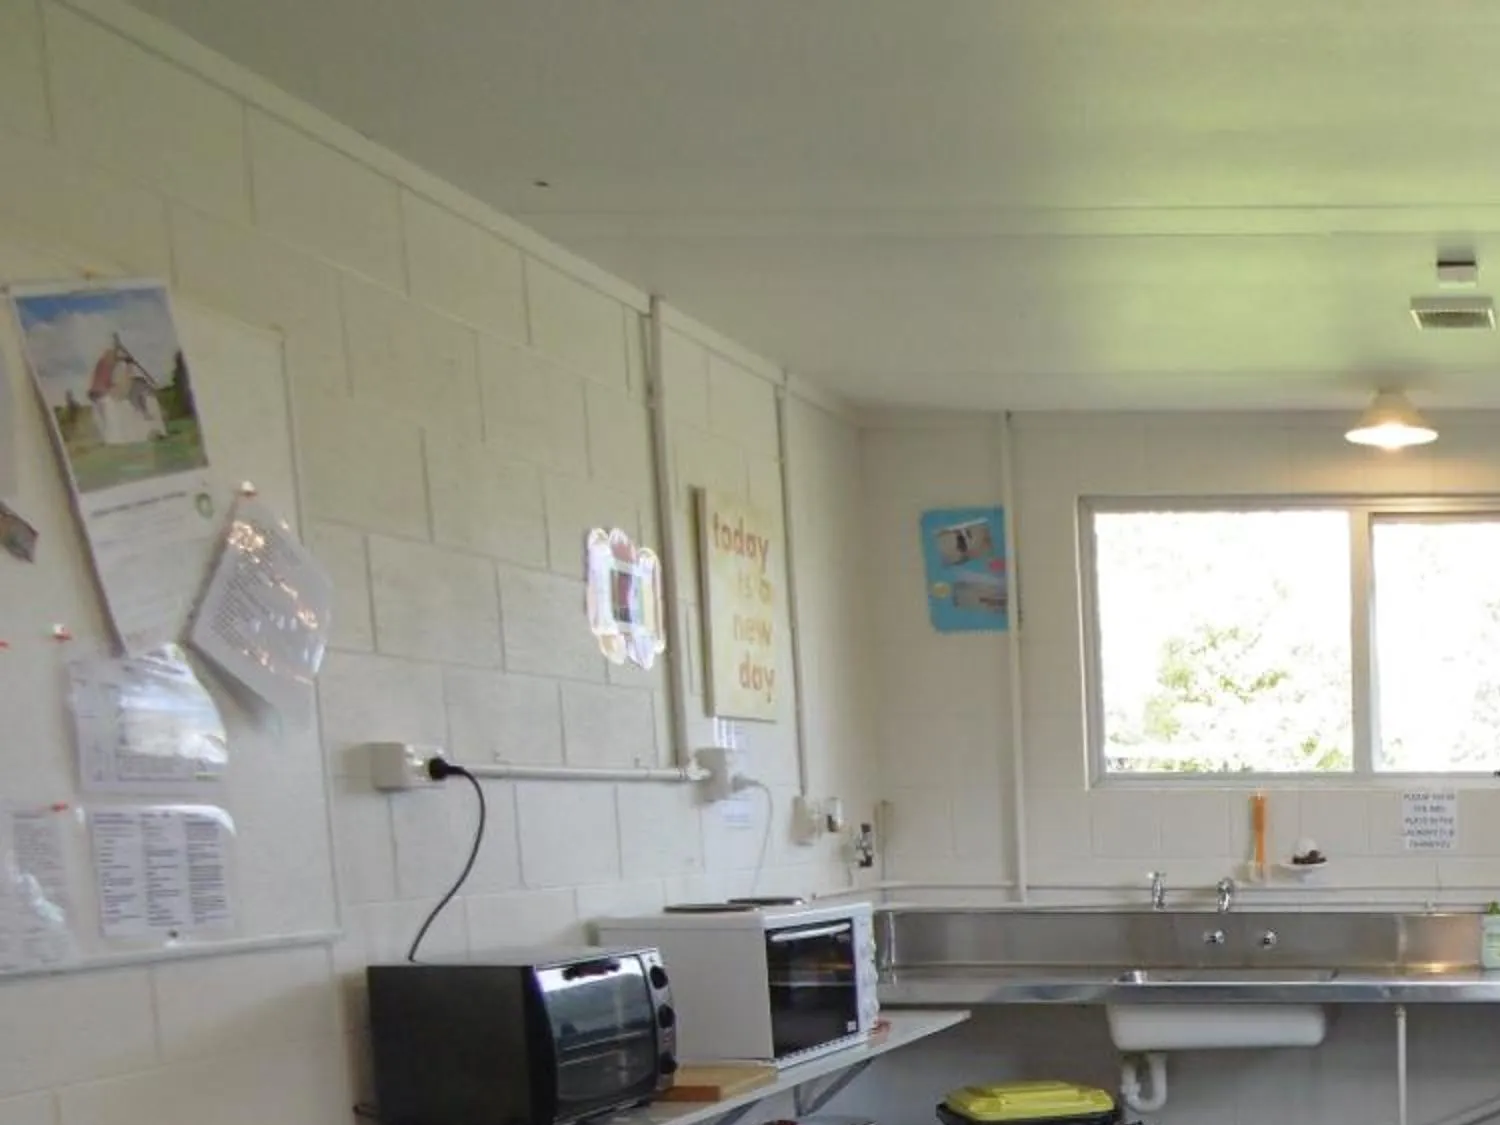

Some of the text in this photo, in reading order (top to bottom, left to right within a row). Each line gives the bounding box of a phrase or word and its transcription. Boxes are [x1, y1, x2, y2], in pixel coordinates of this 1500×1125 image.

[712, 512, 769, 574] today
[733, 613, 774, 646] new
[739, 649, 775, 702] day
